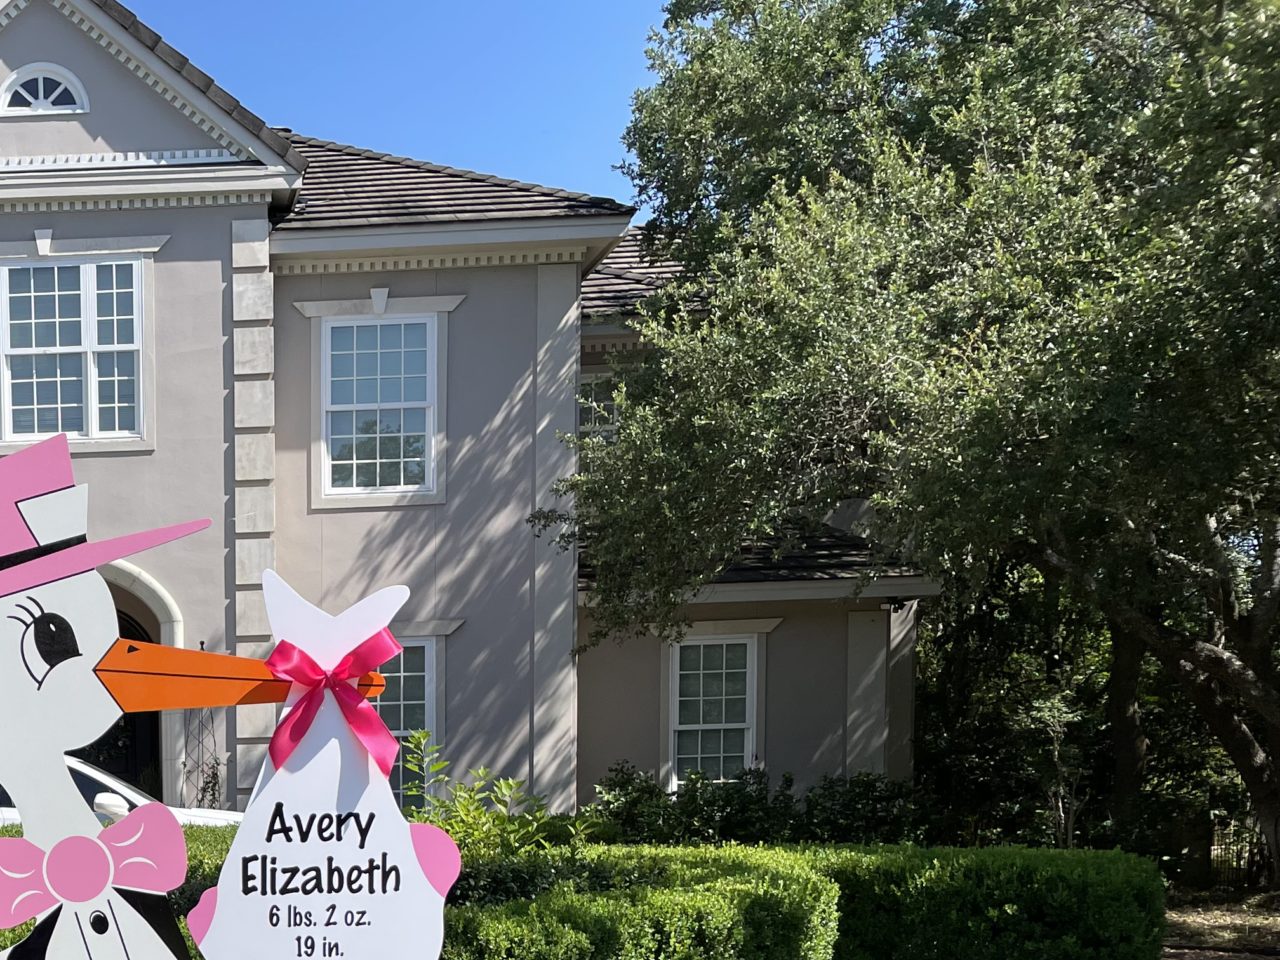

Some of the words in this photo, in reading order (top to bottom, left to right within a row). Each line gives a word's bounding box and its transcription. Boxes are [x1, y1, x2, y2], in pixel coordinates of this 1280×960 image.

[265, 802, 375, 849] Avery
[241, 852, 401, 896] Elizabeth
[269, 905, 280, 927] 6
[287, 905, 317, 927] lbs.
[324, 904, 337, 926] 2
[344, 910, 371, 927] oz.
[295, 936, 316, 957] 19
[322, 937, 344, 957] in.
